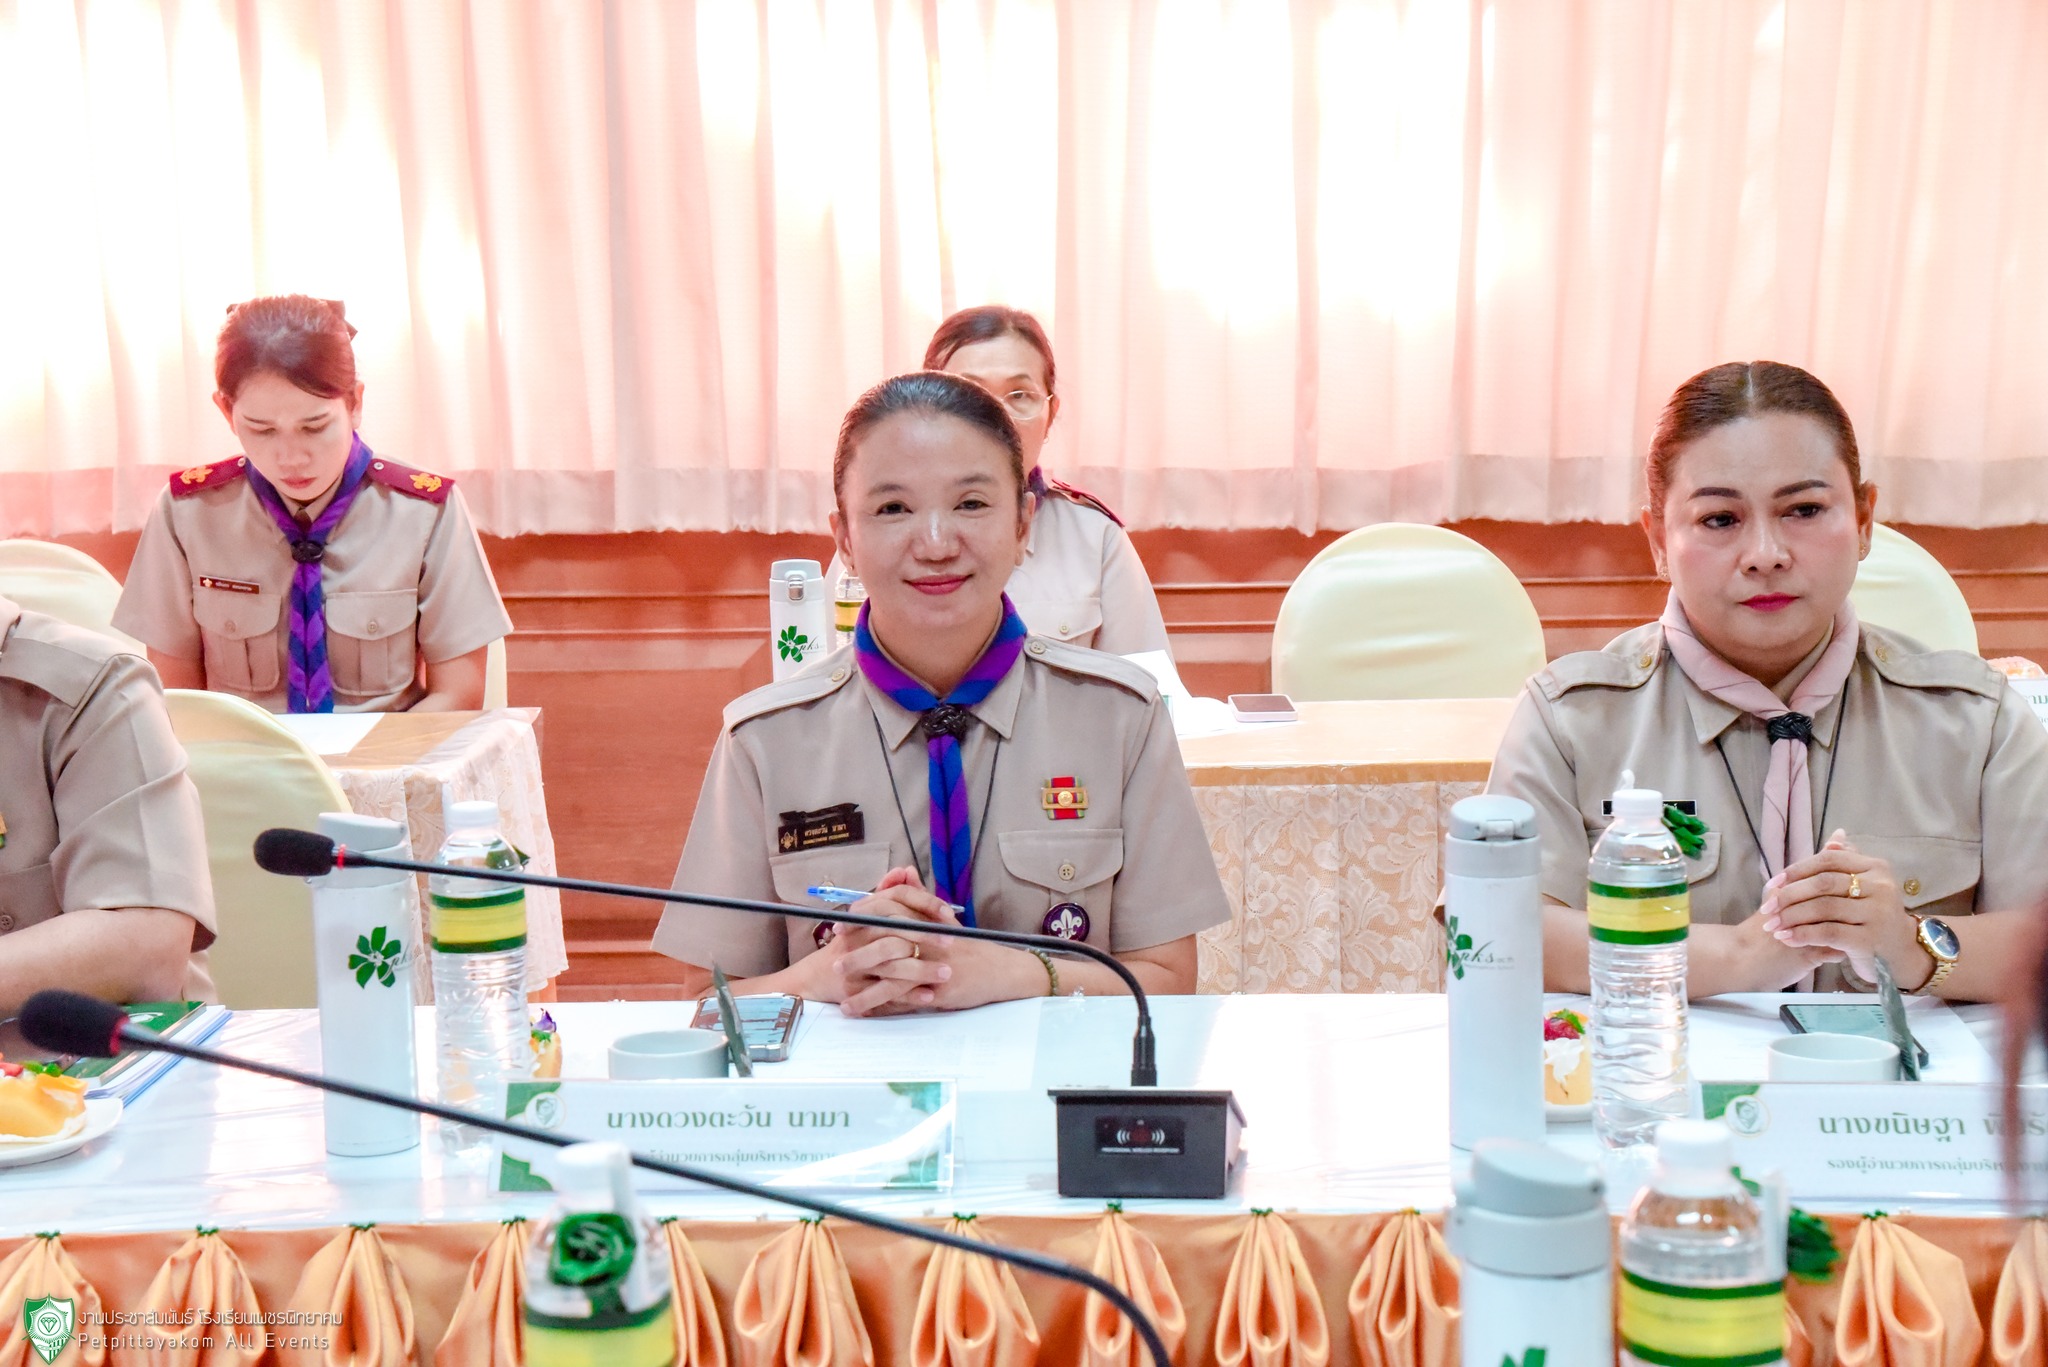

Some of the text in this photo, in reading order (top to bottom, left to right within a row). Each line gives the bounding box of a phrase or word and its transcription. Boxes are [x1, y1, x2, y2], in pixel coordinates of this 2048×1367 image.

[607, 1104, 850, 1128] นางดวงตะวัน นามา
[1818, 1112, 1966, 1143] นางขนิษฐา
